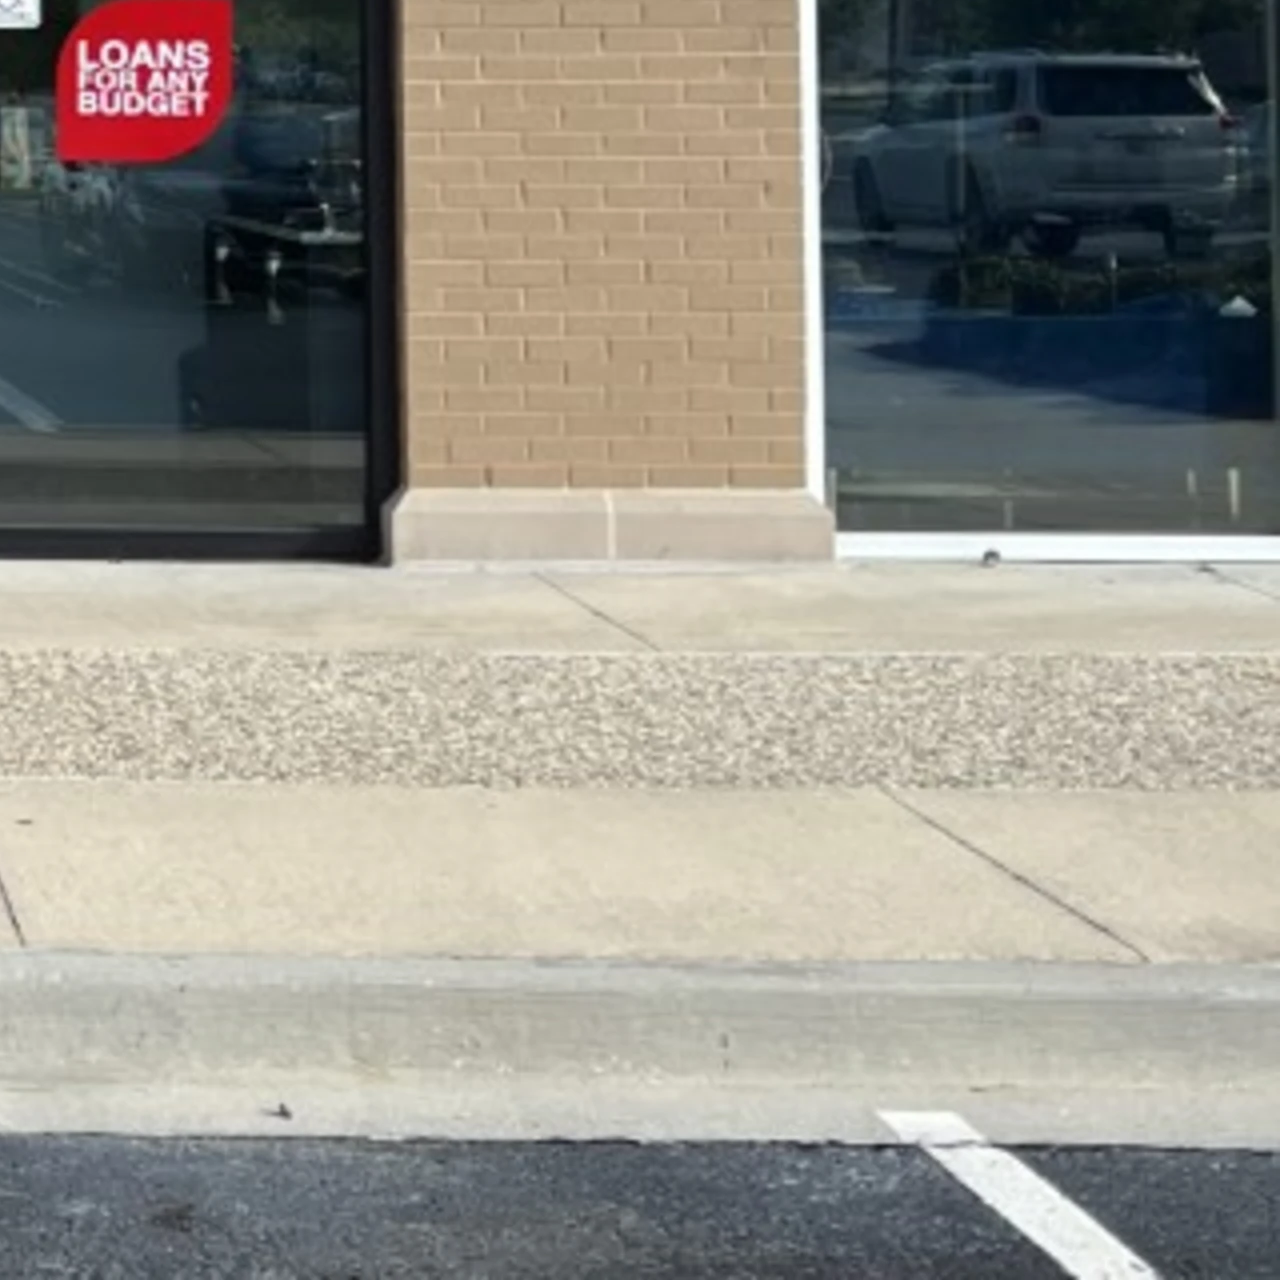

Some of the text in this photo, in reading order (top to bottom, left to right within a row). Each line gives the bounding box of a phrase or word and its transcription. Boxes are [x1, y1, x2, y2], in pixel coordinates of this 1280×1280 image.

[77, 39, 211, 70] LOANS
[77, 71, 210, 92] FOR ANY
[77, 92, 210, 117] BUDGET
